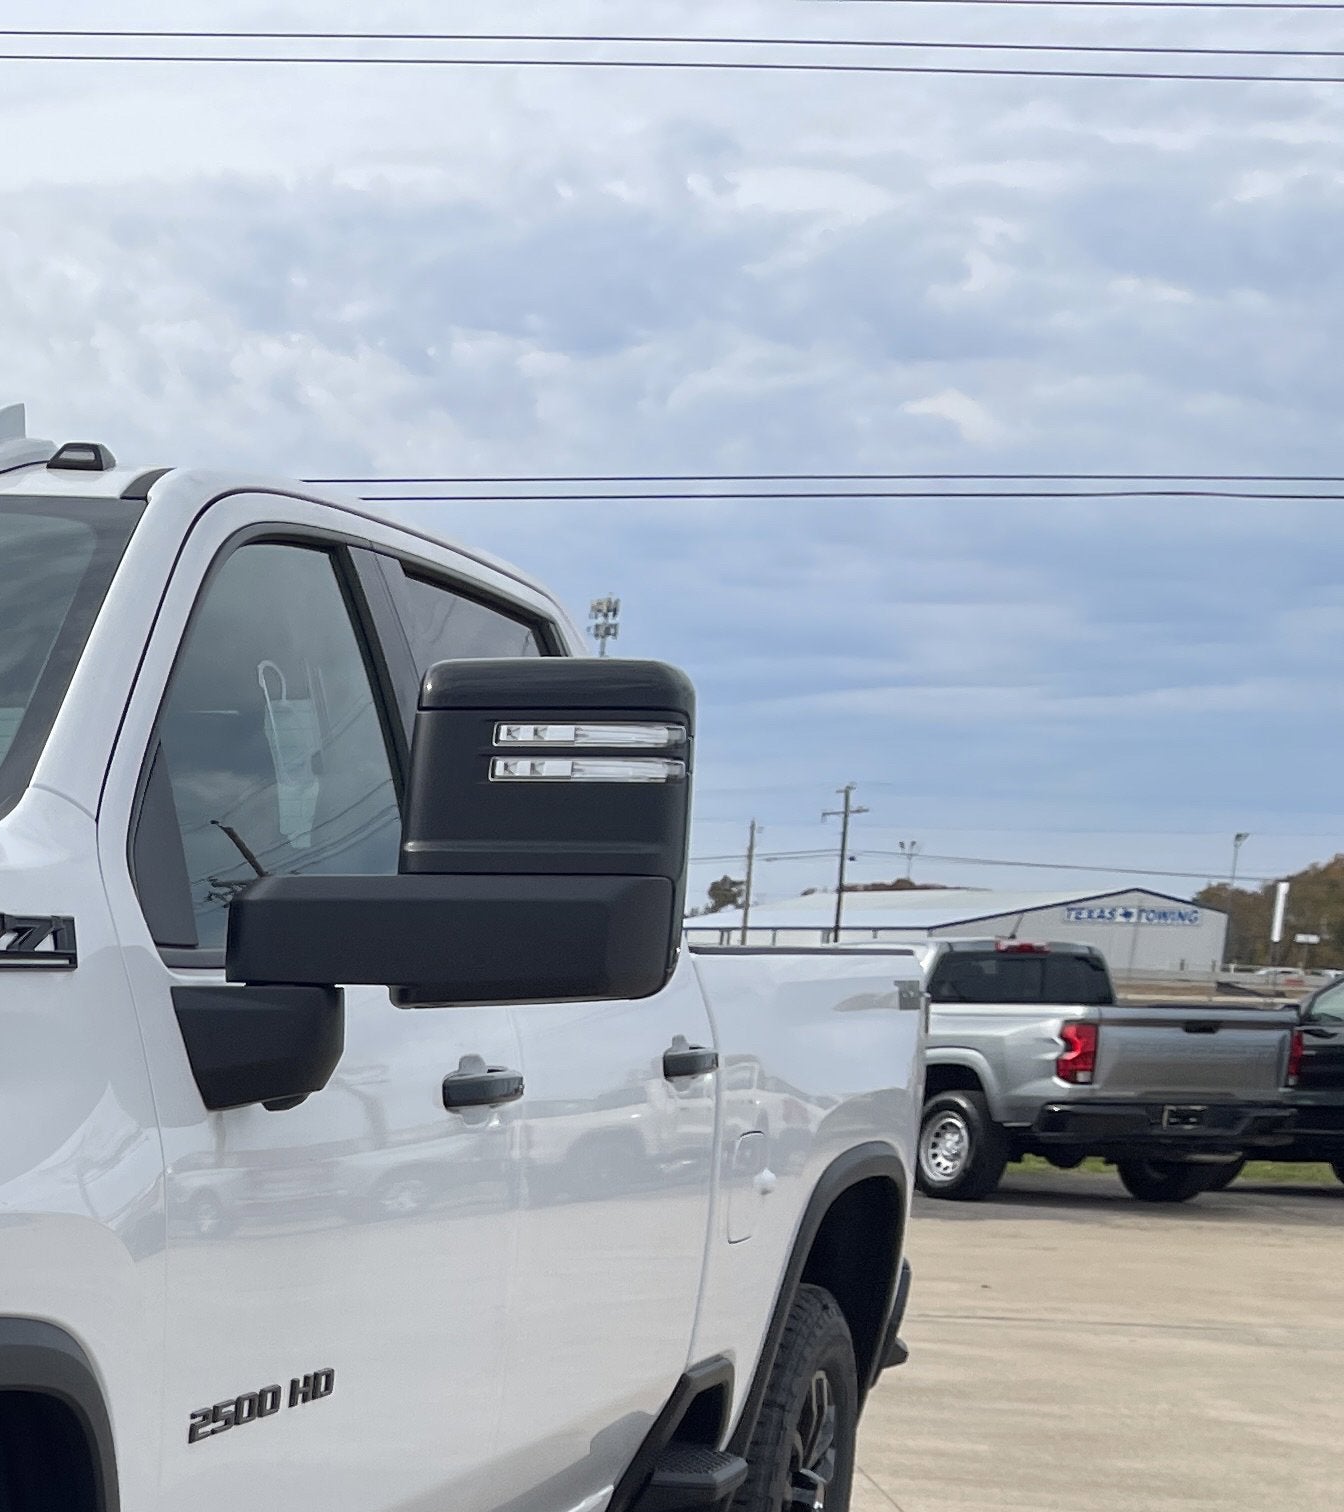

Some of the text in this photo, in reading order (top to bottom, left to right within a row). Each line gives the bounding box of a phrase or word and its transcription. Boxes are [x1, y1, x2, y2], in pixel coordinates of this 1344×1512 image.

[1066, 906, 1200, 925] TEXAS TOWING
[188, 1367, 335, 1444] 2500 HD
